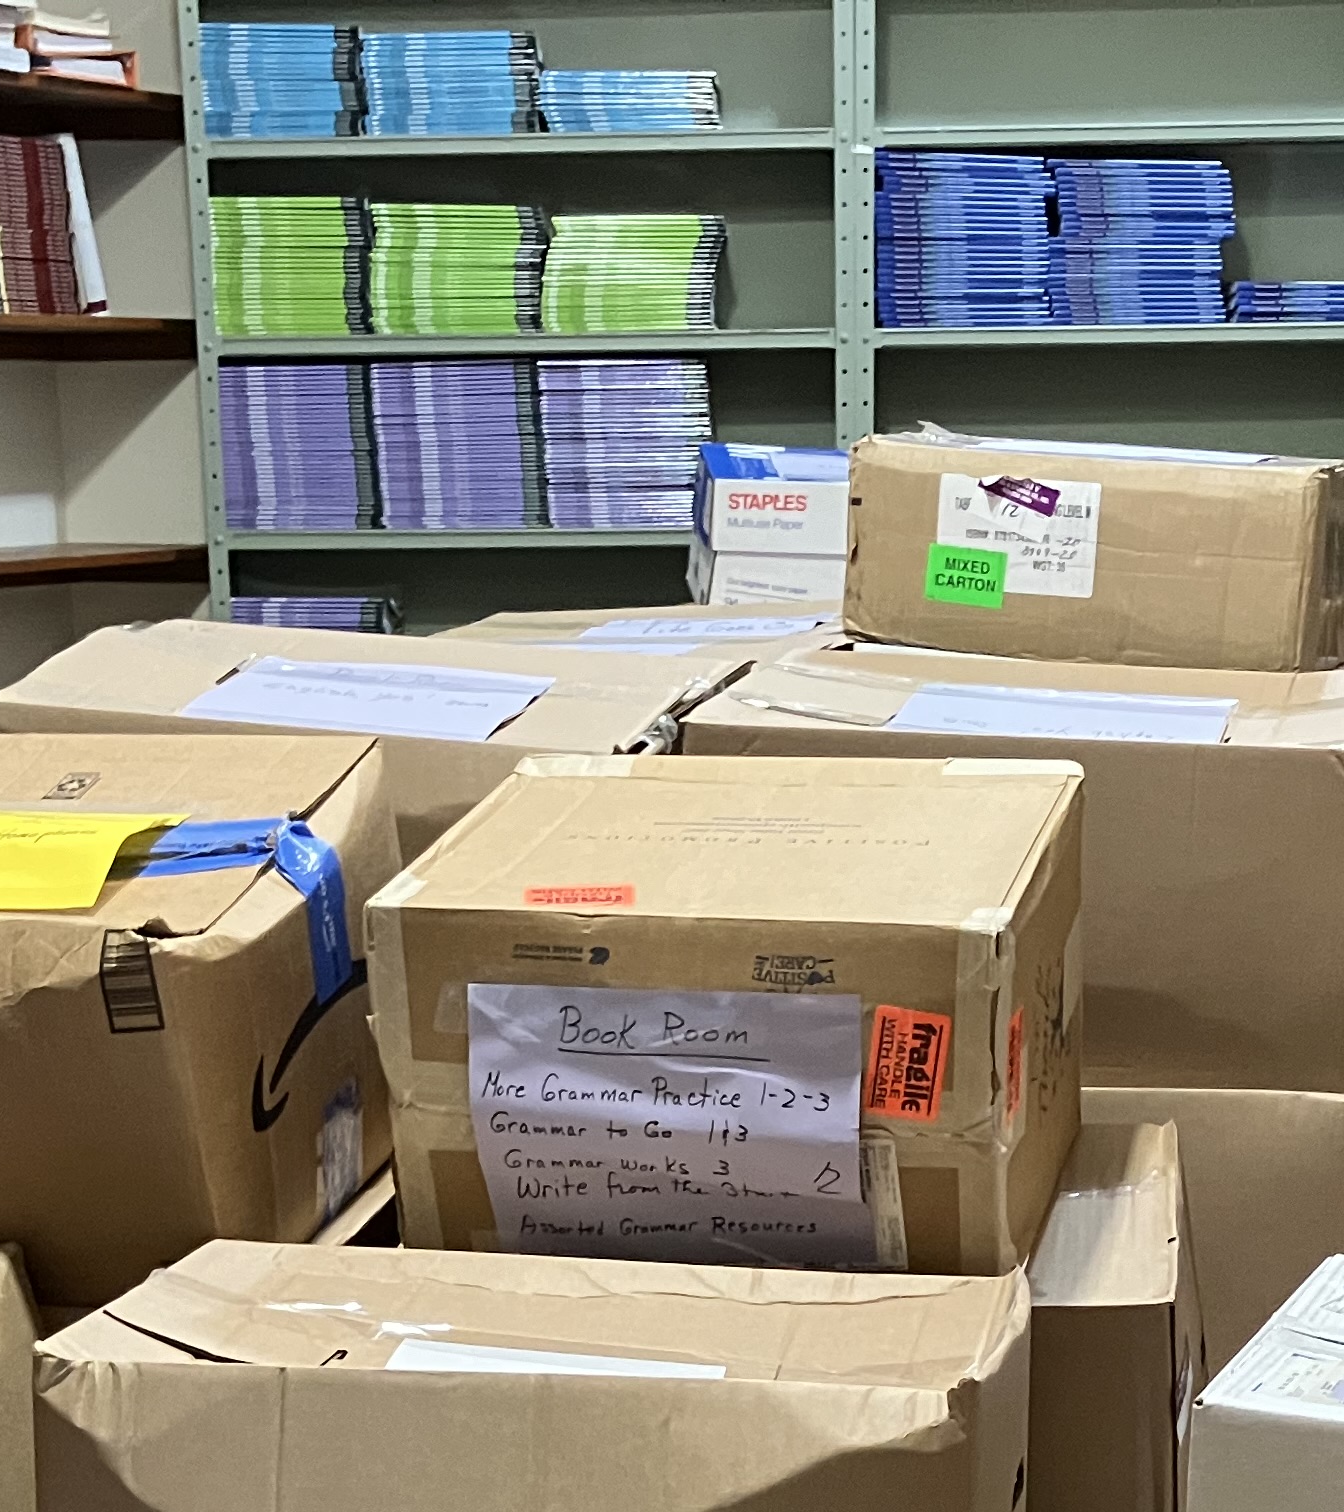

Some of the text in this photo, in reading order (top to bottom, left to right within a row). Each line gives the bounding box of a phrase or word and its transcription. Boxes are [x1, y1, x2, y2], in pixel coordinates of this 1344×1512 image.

[728, 493, 808, 512] STAPLES
[944, 556, 991, 576] MIXED
[934, 573, 997, 592] CARTON
[559, 1005, 749, 1049] Book Room
[874, 1018, 898, 1109] WITH CARE
[889, 1032, 909, 1099] HANDLE
[900, 1022, 938, 1113] fragile
[482, 1070, 830, 1112] More Grammar Practice 1-2-3
[490, 1111, 587, 1137] Grammar
[606, 1120, 628, 1140] to
[644, 1120, 673, 1138] Go
[505, 1149, 604, 1169] Grammar
[713, 1160, 730, 1176] 3
[517, 1175, 588, 1199] Write
[607, 1171, 661, 1199] from
[673, 1178, 711, 1195] the
[521, 1214, 817, 1237] Assorted Grammar Resources
